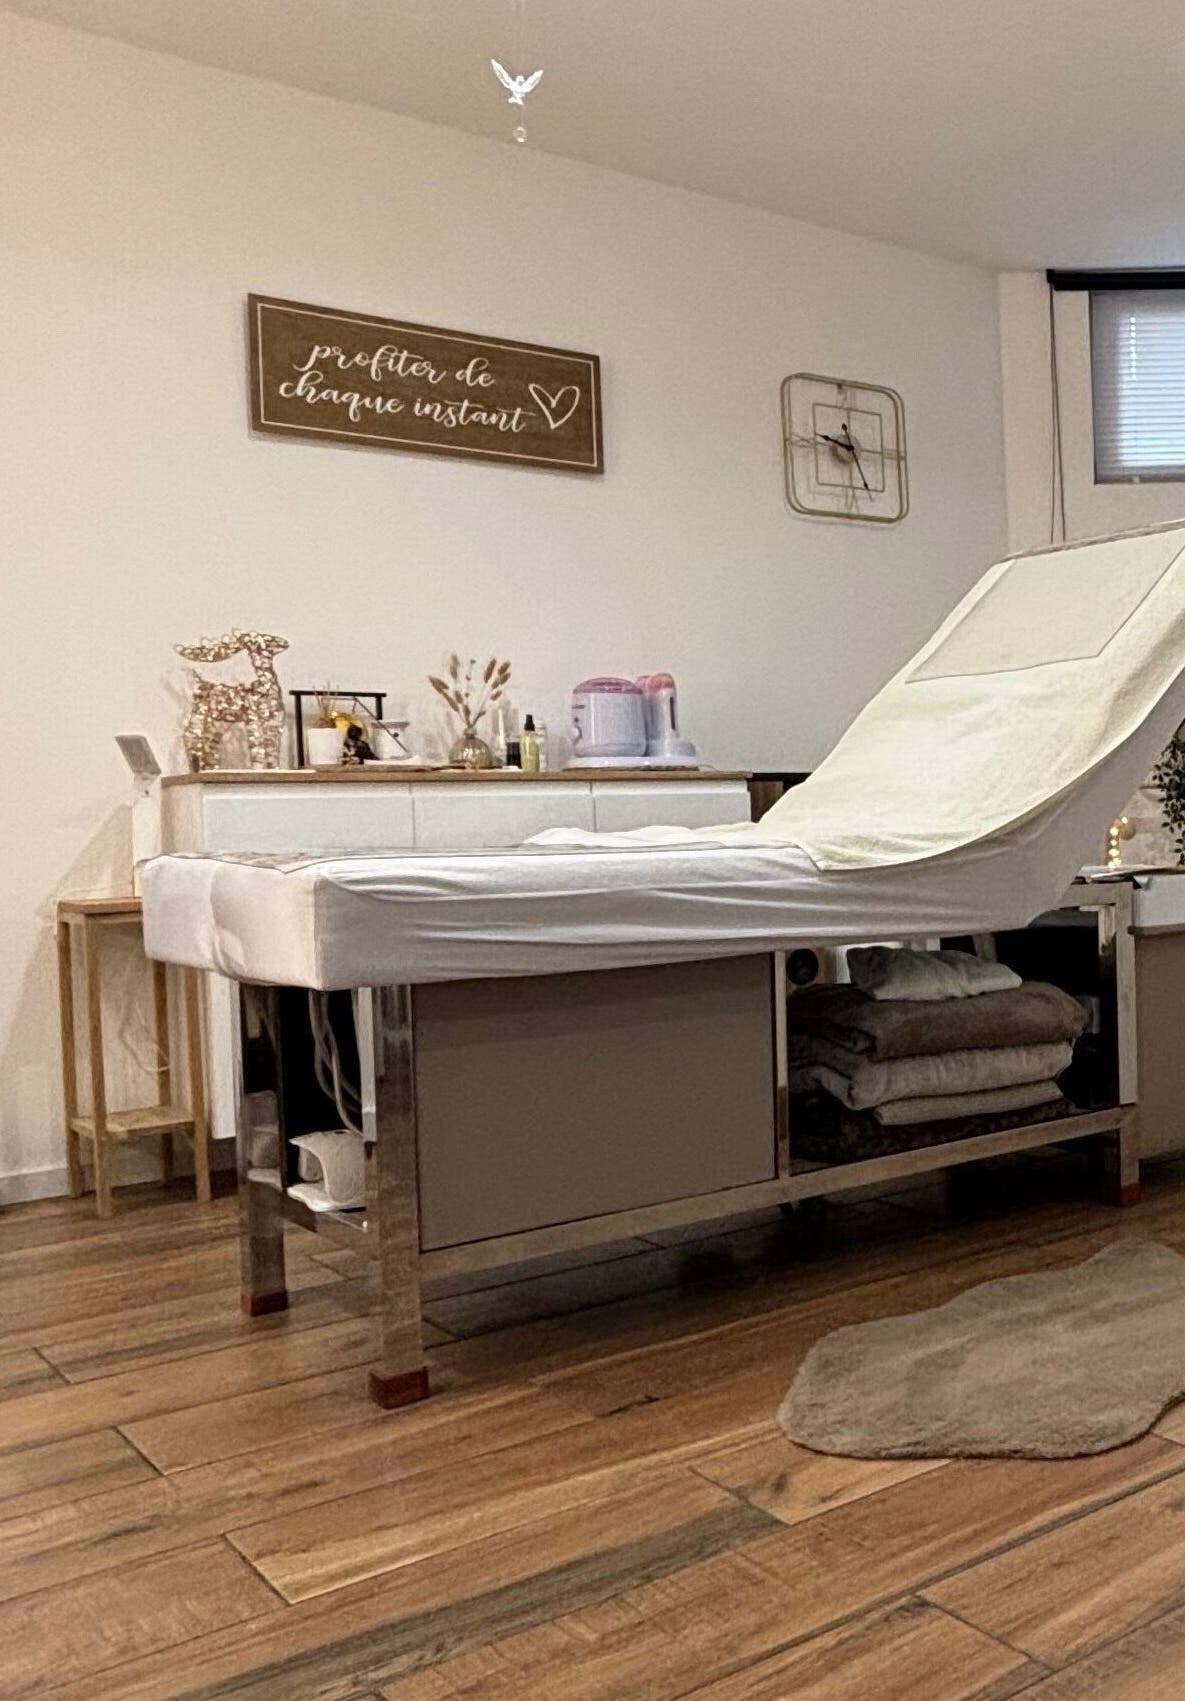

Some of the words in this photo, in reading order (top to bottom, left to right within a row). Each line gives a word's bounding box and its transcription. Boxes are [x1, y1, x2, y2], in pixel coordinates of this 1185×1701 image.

[293, 344, 447, 384] profiter
[455, 357, 495, 387] de
[279, 370, 404, 422] chaque
[413, 396, 536, 433] instant
